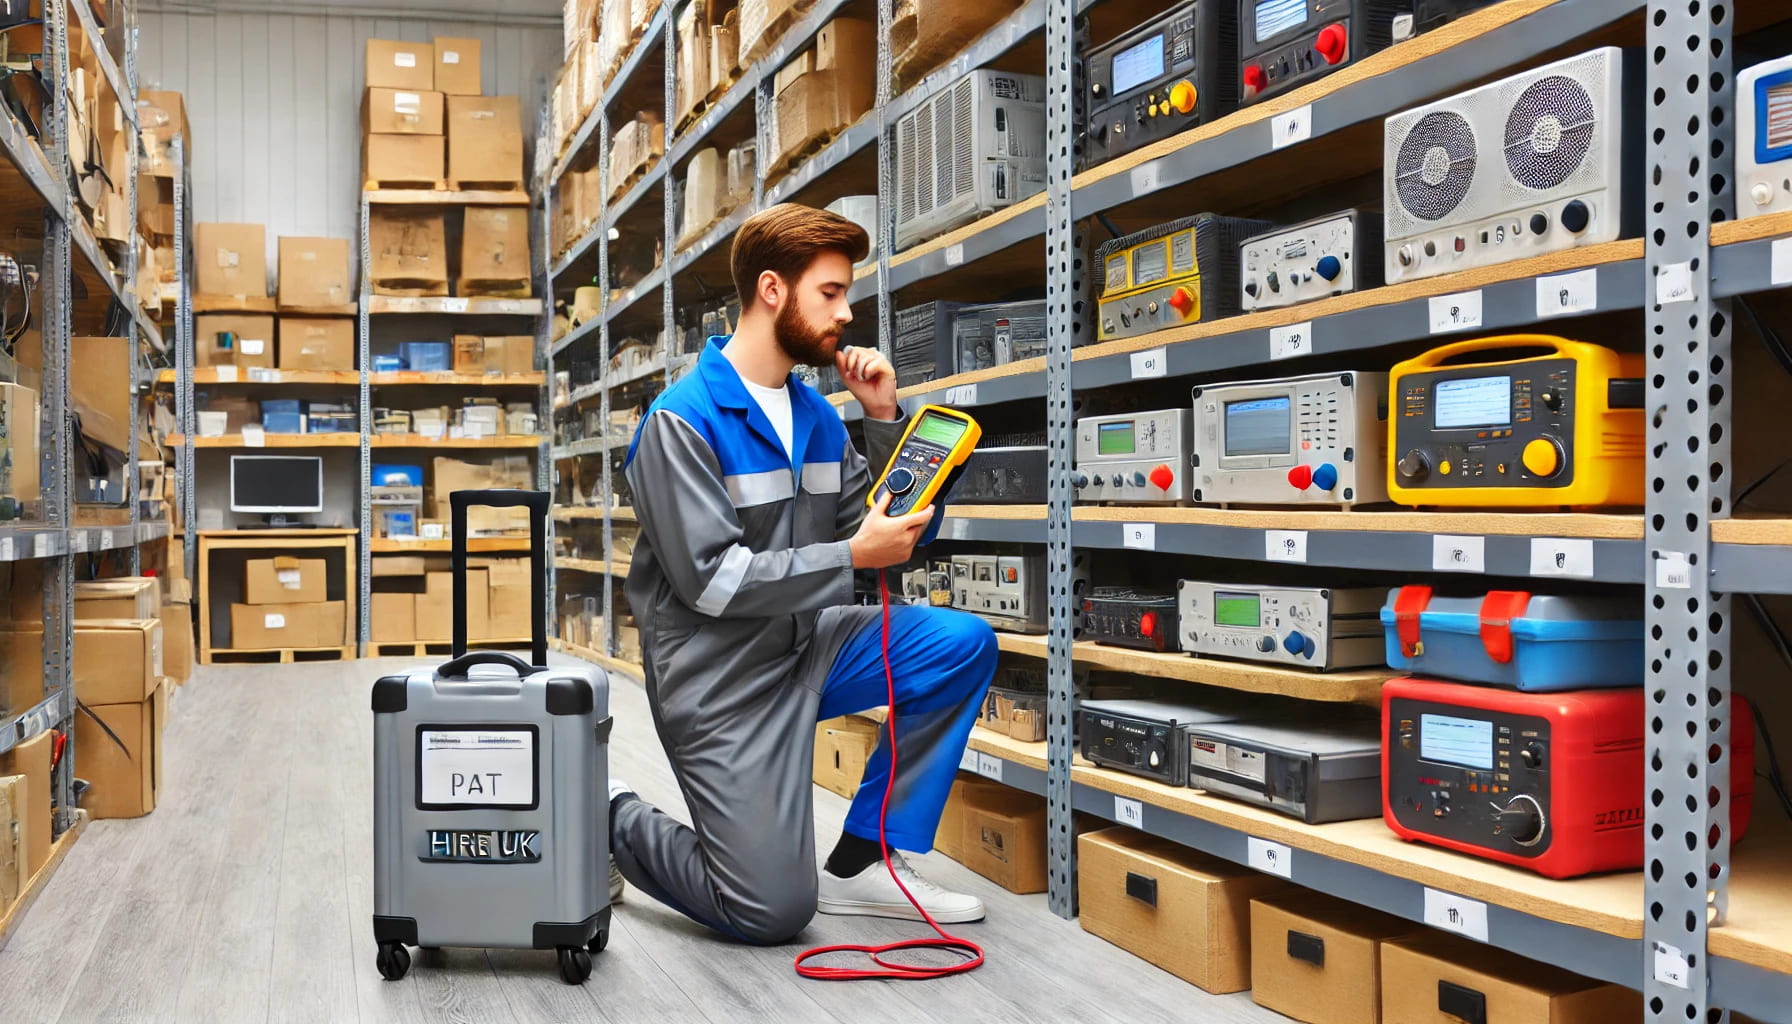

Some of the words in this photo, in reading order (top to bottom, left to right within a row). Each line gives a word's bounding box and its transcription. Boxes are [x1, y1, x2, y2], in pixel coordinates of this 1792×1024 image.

[451, 773, 502, 797] PAT
[431, 831, 491, 857] HIRE
[500, 831, 537, 857] UK
